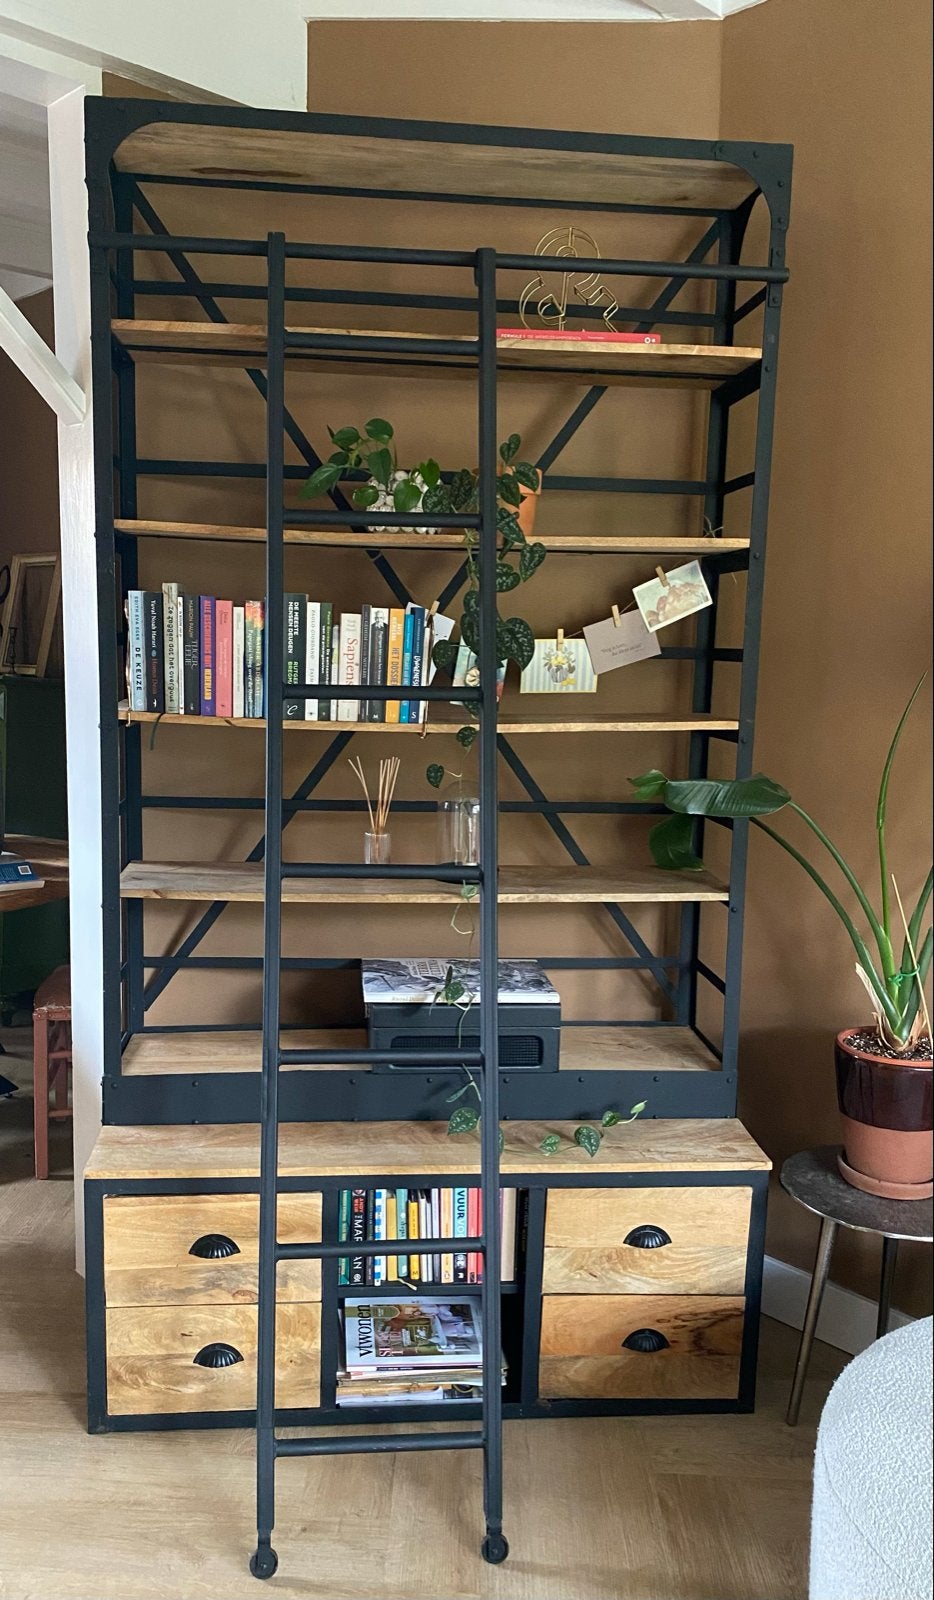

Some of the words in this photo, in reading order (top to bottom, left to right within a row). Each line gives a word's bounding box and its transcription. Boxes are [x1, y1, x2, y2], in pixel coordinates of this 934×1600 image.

[294, 602, 299, 610] DE
[136, 647, 141, 658] DE
[390, 661, 399, 686] DOSSIE
[356, 1304, 373, 1357] vtwonen
